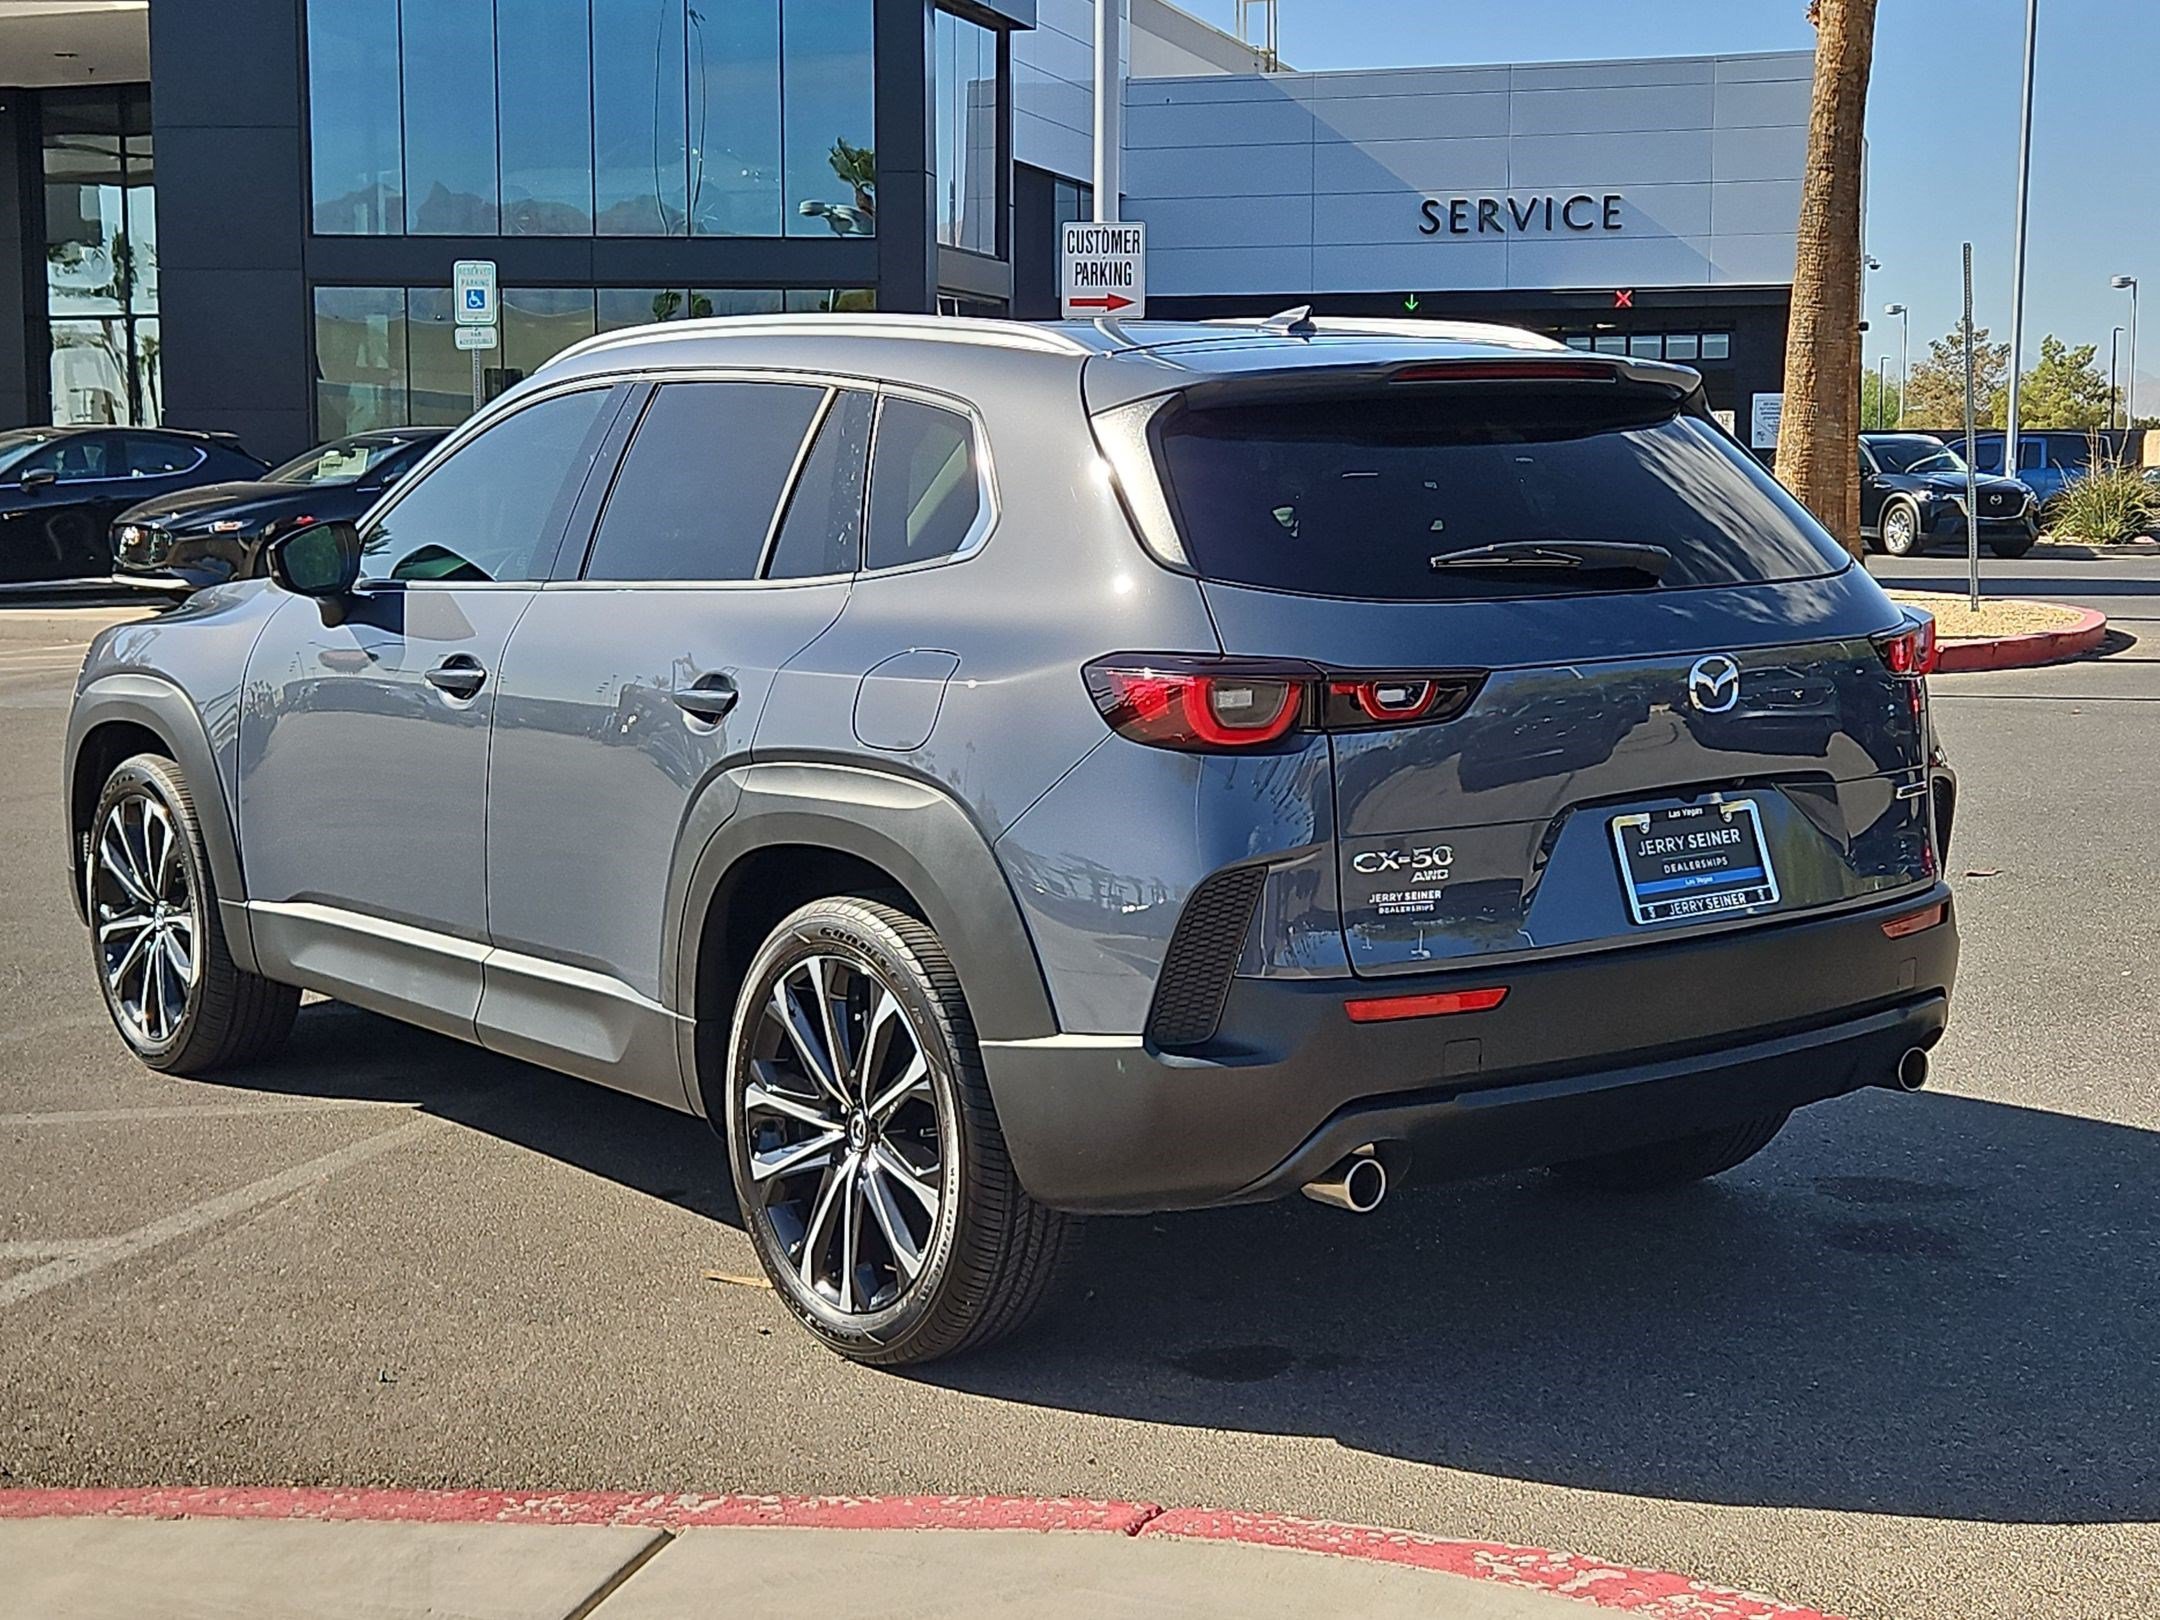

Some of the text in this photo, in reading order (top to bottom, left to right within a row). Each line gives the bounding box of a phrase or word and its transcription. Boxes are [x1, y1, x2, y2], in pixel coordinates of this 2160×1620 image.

[1418, 194, 1623, 235] SERVICE
[1067, 229, 1141, 254] CUSTOMER
[1074, 261, 1132, 287] PARKING
[1668, 808, 1703, 819] Las Vegas
[1638, 828, 1741, 857] JERRY SEINER
[1353, 845, 1454, 873] CX-50
[1663, 856, 1729, 874] DEALERSHIPS
[1410, 869, 1449, 883] AWD
[1369, 890, 1442, 904] JERRY SEINER
[1669, 892, 1747, 916] JERRY SEINER
[1378, 904, 1435, 915] DEALERSHIPS
